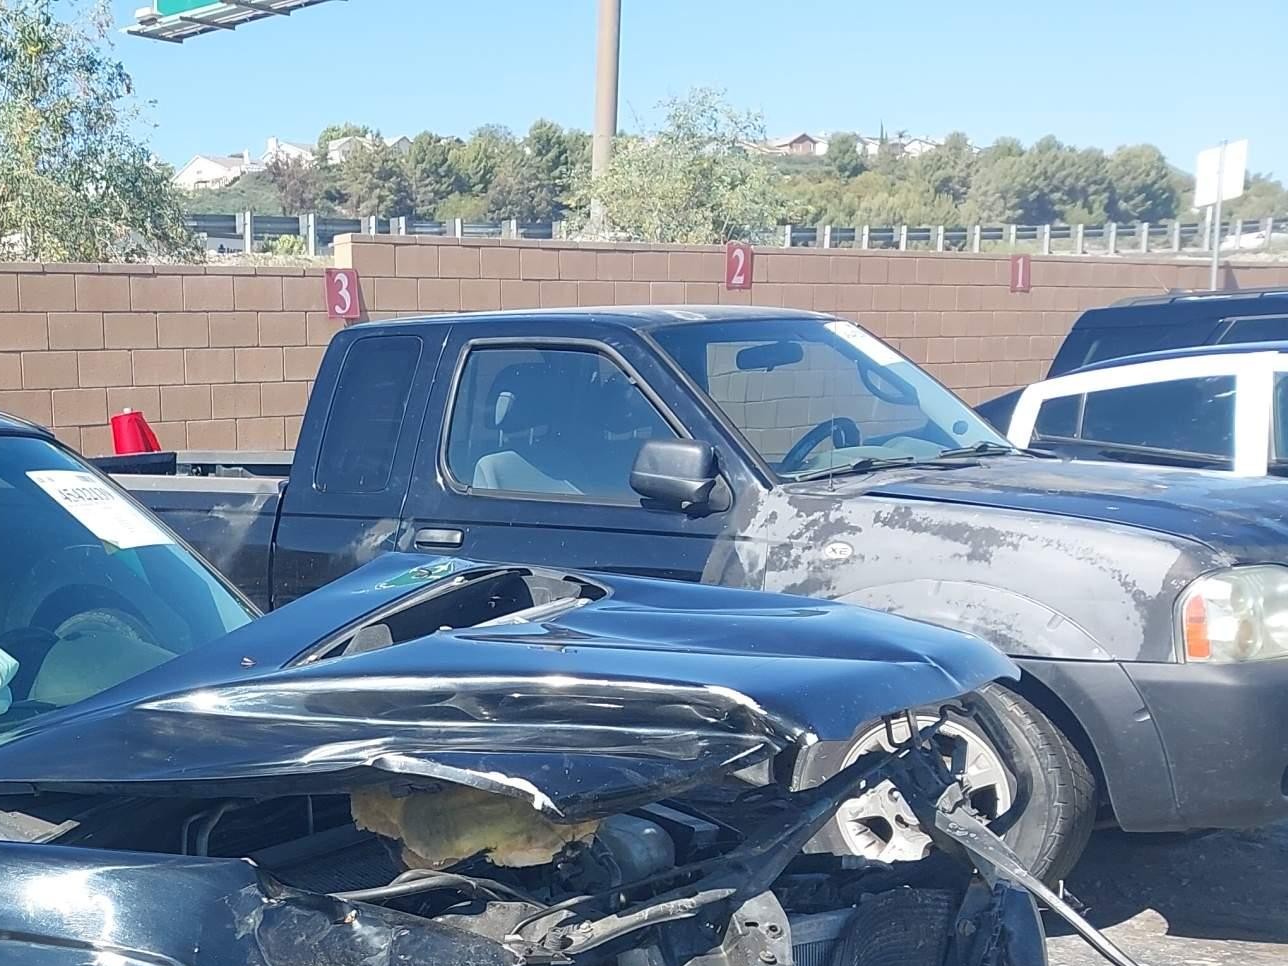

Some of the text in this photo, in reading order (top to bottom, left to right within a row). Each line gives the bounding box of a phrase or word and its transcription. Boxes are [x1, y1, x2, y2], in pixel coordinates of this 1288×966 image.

[731, 248, 745, 284] 2
[1016, 257, 1024, 288] 1
[334, 272, 351, 314] 3
